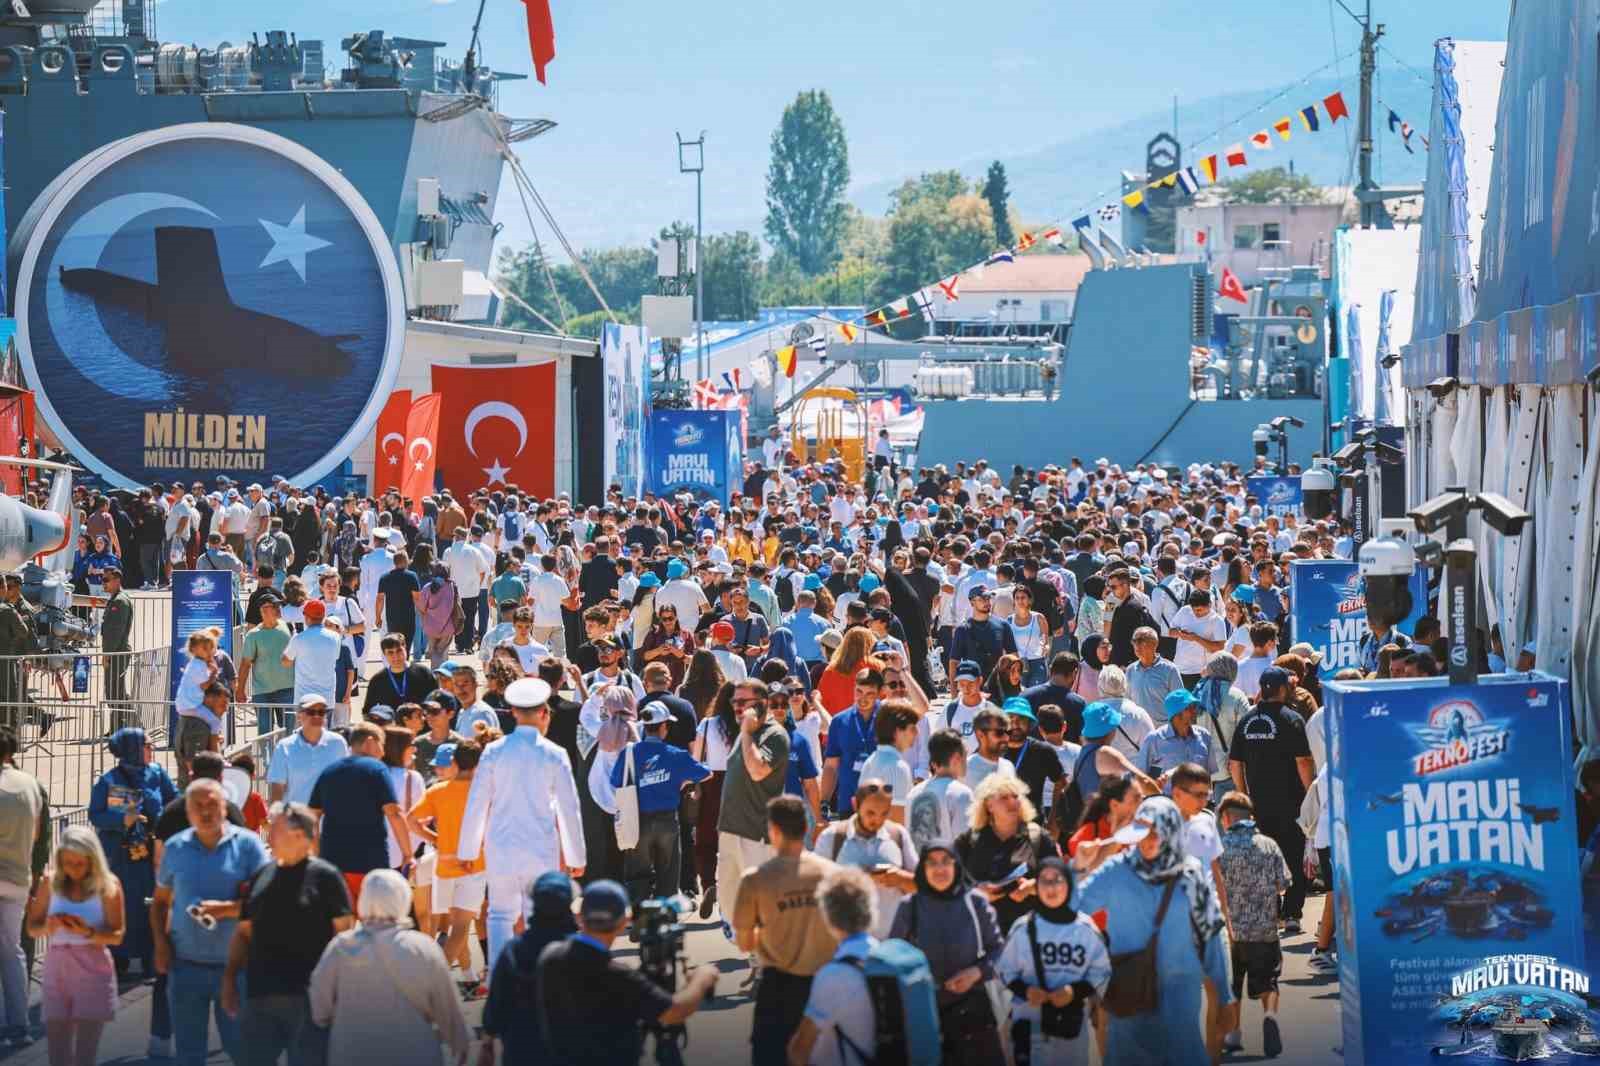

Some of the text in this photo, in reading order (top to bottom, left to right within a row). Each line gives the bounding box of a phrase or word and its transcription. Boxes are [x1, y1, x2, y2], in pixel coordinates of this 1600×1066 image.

[144, 407, 266, 449] MİLDEN
[144, 448, 265, 470] MİLLİ DENİZALTI
[1452, 586, 1465, 644] aselsan
[1414, 731, 1508, 775] TEKNOFEST
[1386, 820, 1545, 875] VATAN
[1390, 955, 1440, 969] Festival
